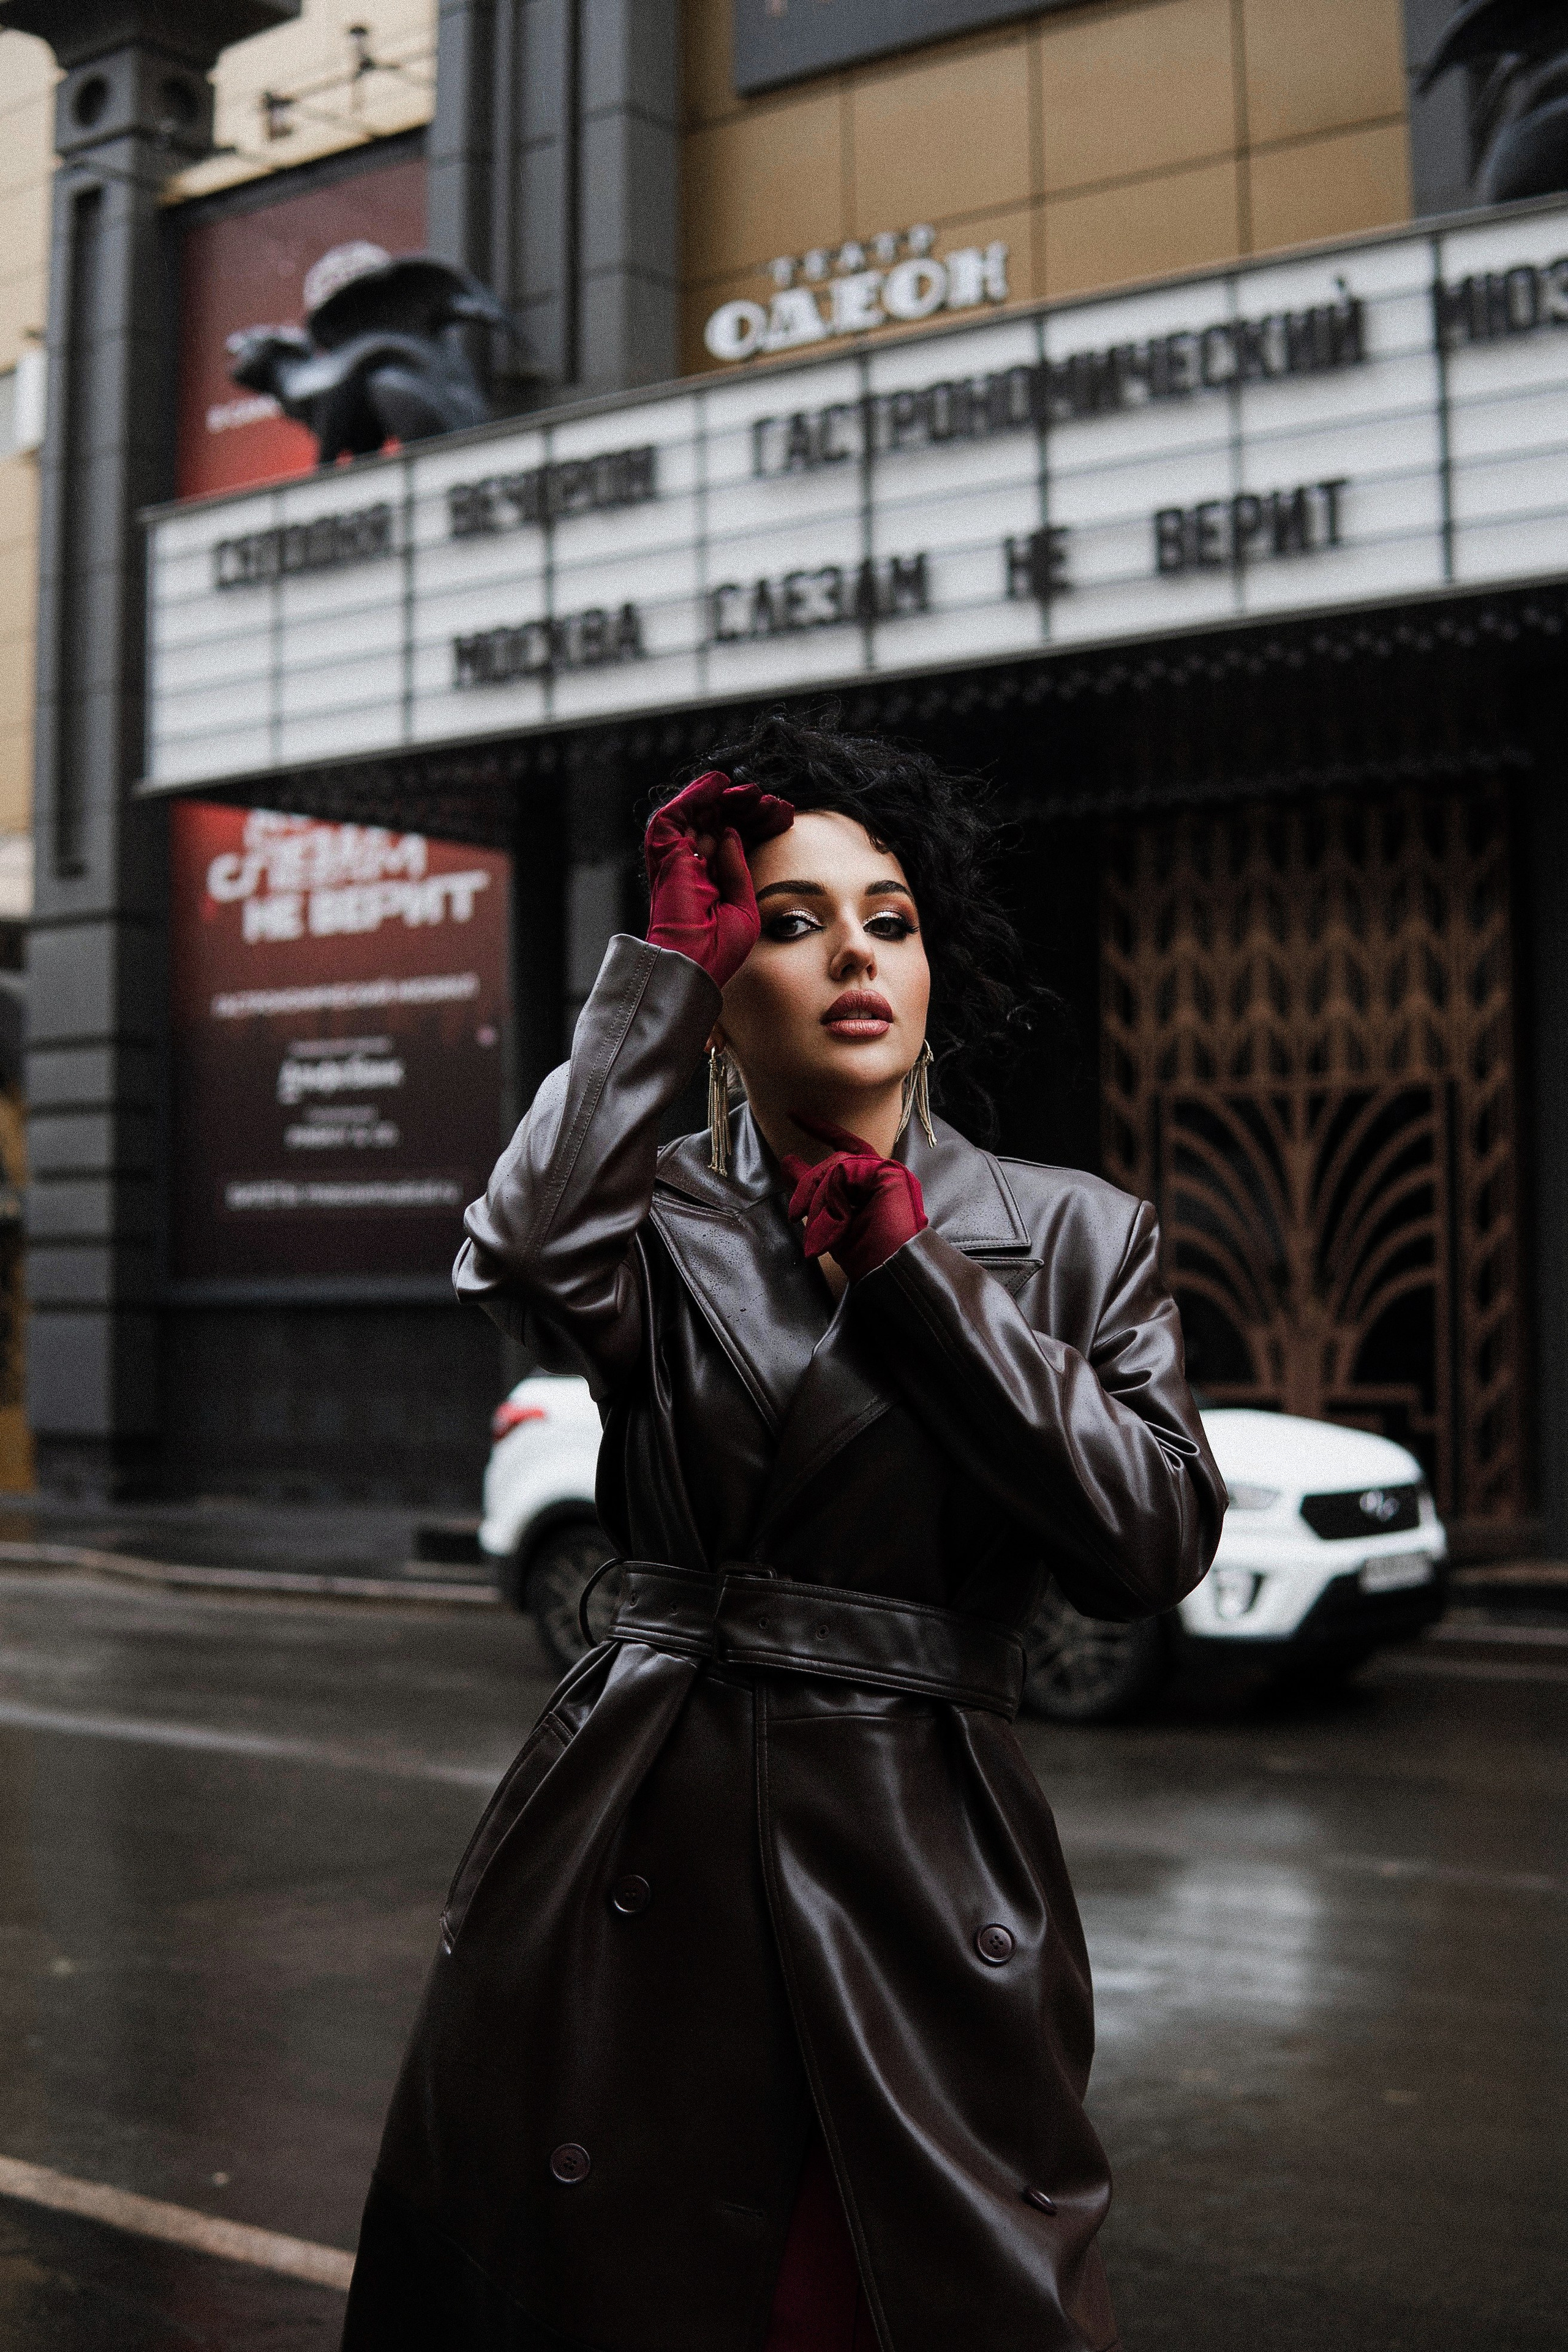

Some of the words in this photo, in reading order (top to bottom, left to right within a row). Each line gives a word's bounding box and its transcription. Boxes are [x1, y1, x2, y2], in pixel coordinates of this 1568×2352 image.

[703, 240, 1011, 361] ОДЕОН
[751, 274, 1368, 479] ГАСТРОНОМИЧЕСКИЙ
[452, 603, 648, 691] МОСКВА
[712, 551, 931, 642] СЛЕЗАМ
[1002, 524, 1073, 600] НЕ
[1154, 477, 1349, 577] ВЕРИТ
